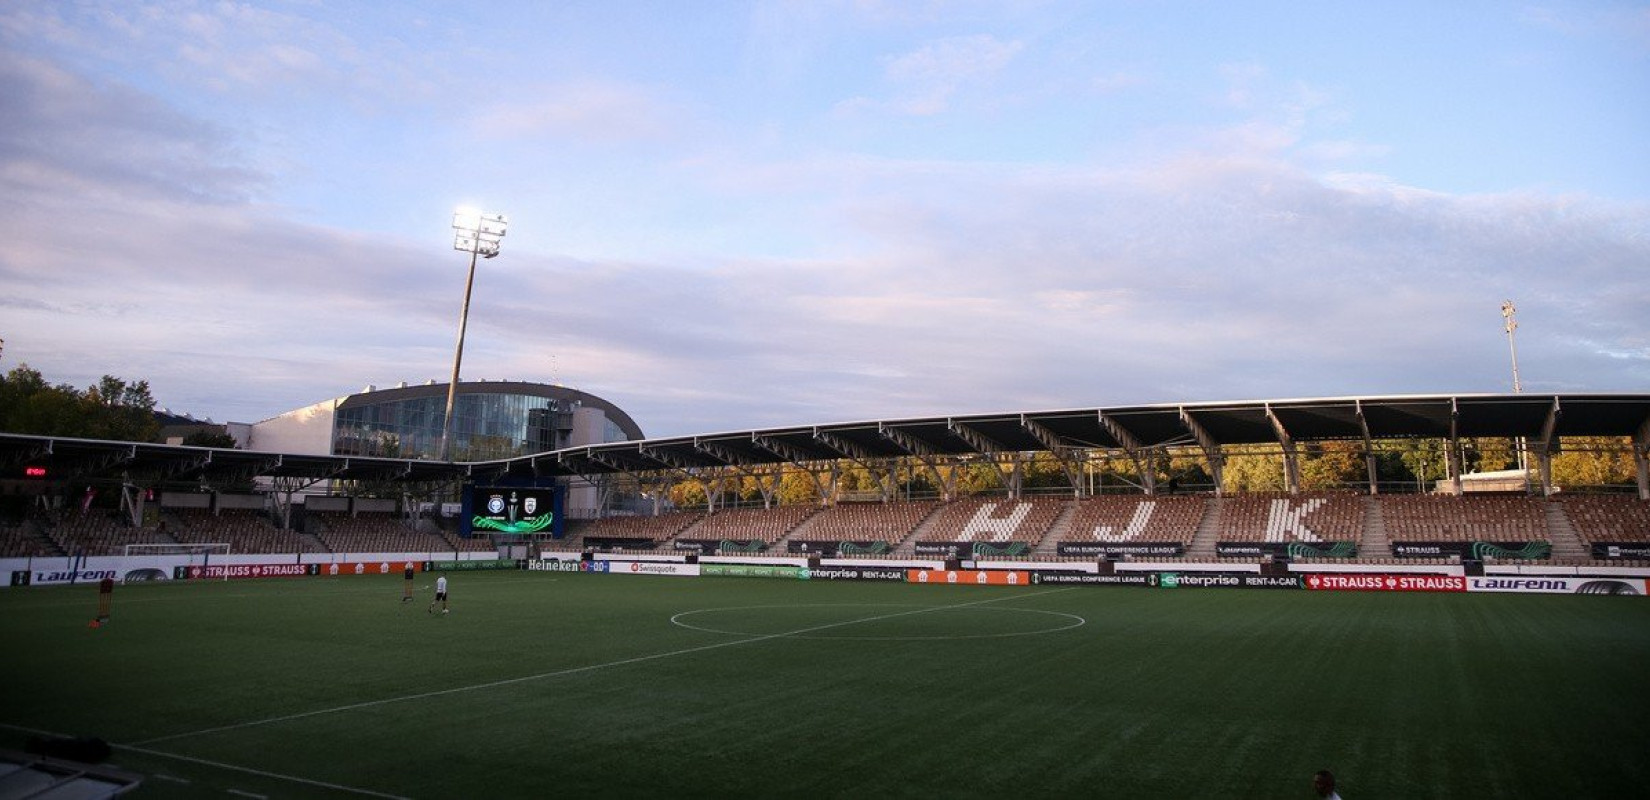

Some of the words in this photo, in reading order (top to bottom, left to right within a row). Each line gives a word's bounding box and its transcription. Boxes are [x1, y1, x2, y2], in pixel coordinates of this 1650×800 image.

[955, 502, 1033, 542] H
[1093, 500, 1156, 542] J
[1264, 498, 1327, 542] K
[1405, 546, 1440, 554] STRAUSS
[203, 566, 250, 577] STRAUSS
[262, 564, 305, 576] STRAUSS
[528, 559, 578, 572] Heineken
[638, 563, 677, 574] Swissquote
[801, 568, 858, 580] enterprise
[862, 570, 901, 579] RENT-A-CAR
[1162, 574, 1240, 587] enterprise
[1245, 576, 1297, 586] RENT-A-CAR
[1322, 576, 1383, 588] STRAUSS
[1400, 577, 1463, 589] STRAUSS
